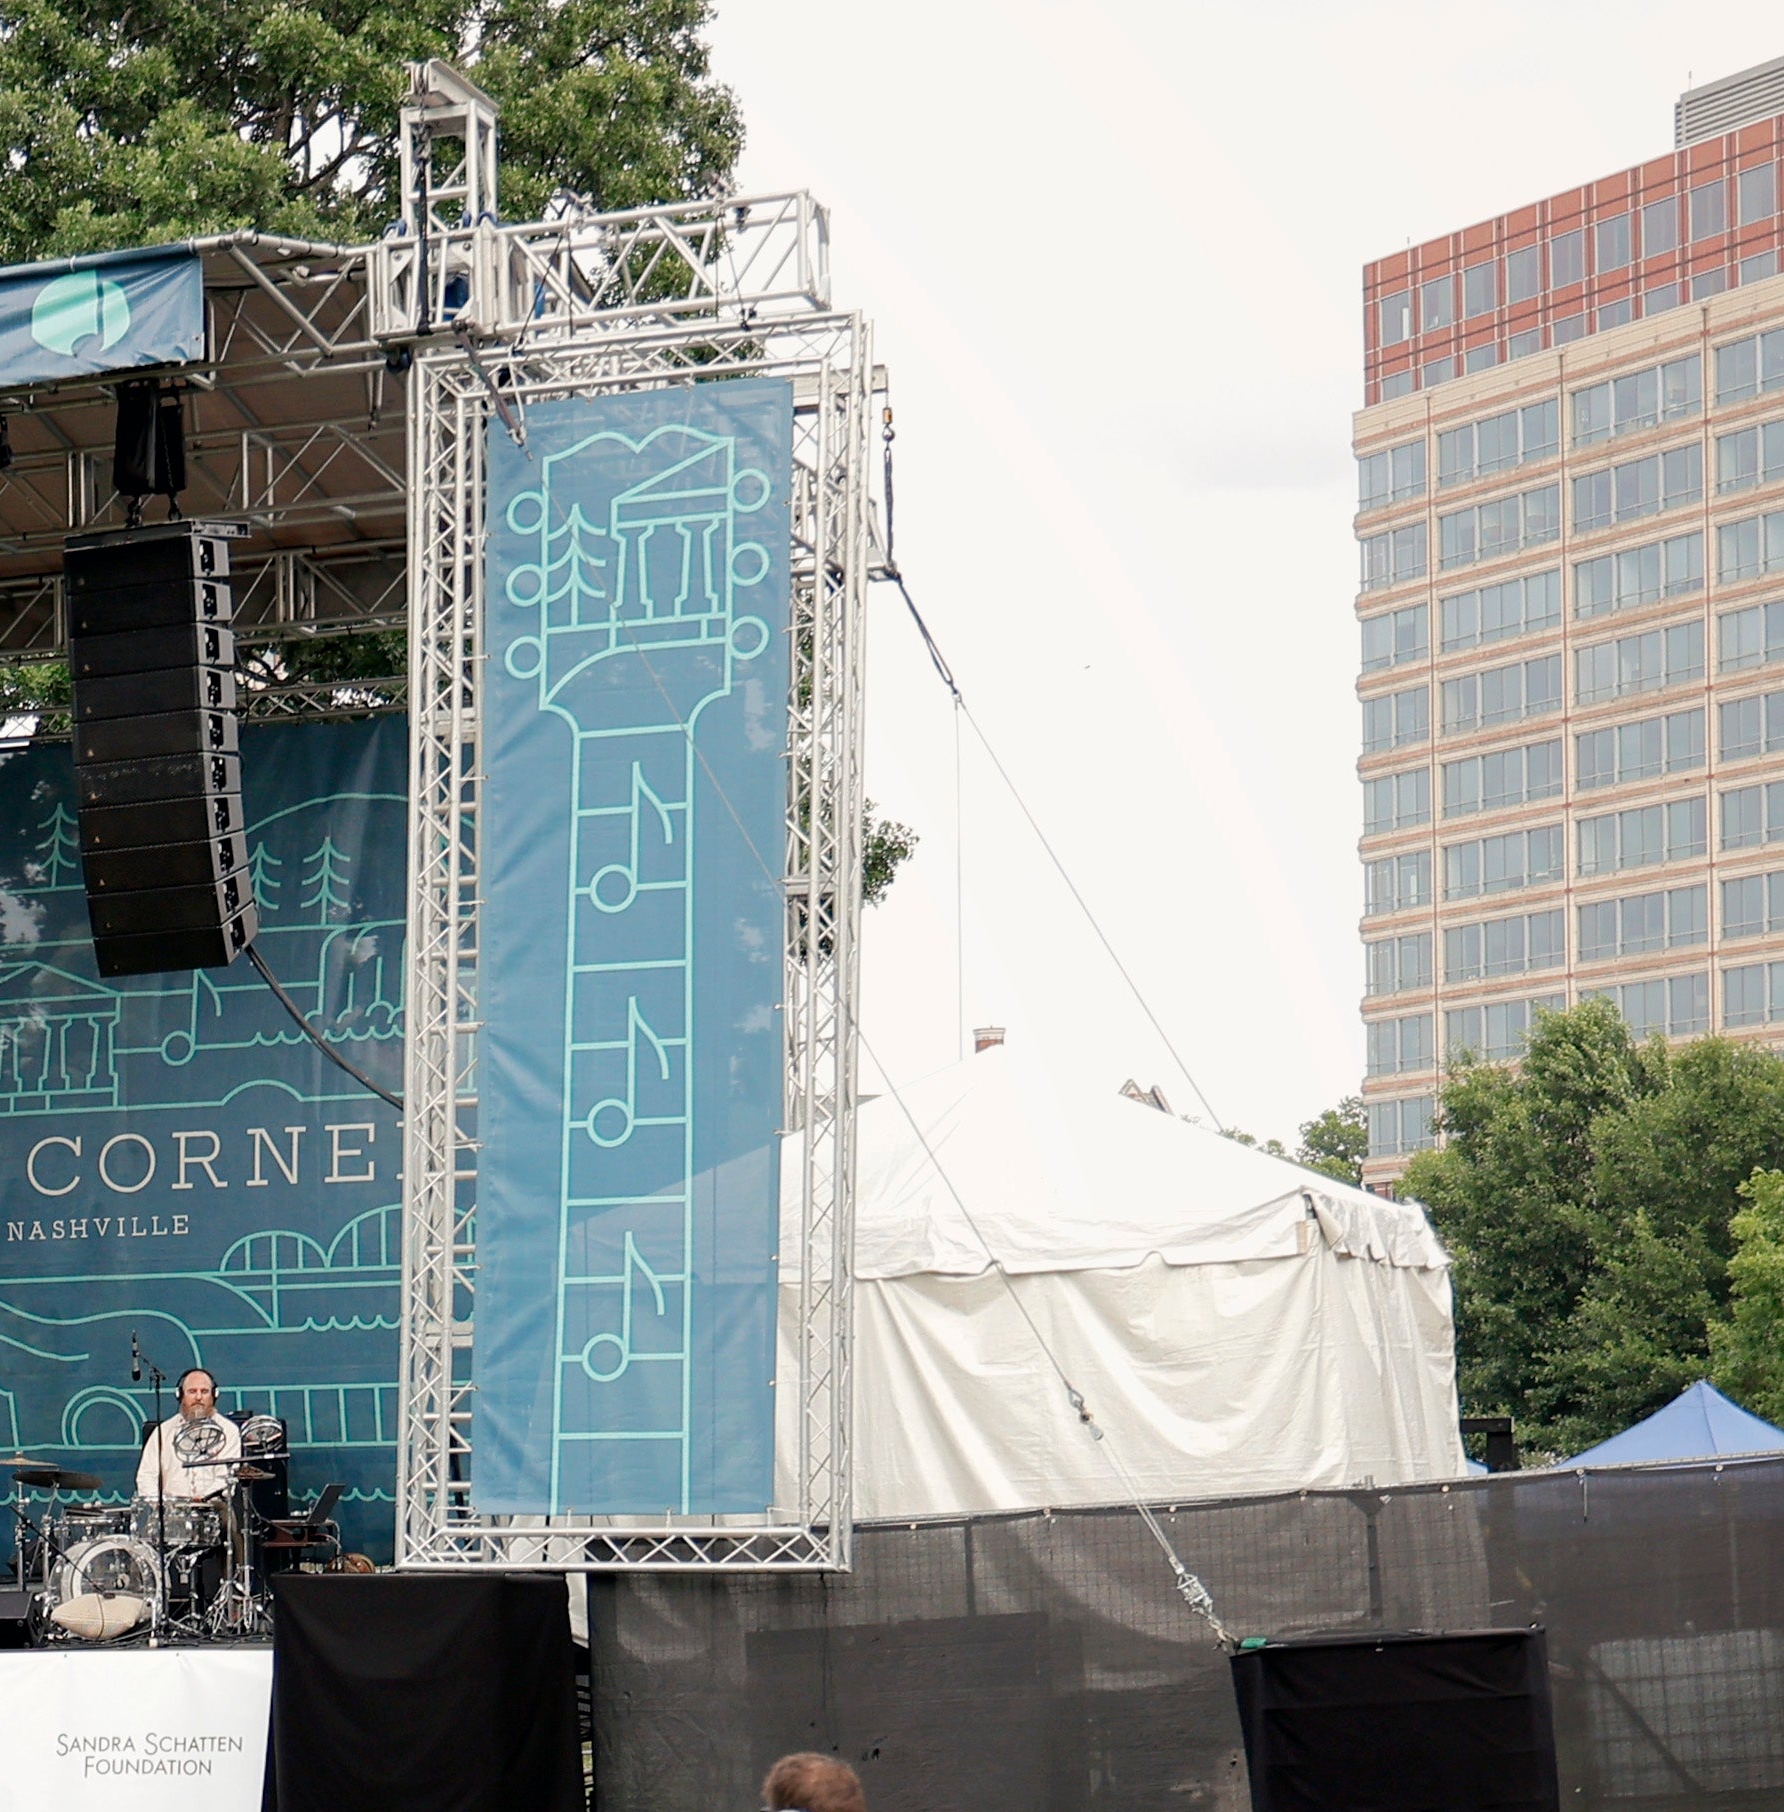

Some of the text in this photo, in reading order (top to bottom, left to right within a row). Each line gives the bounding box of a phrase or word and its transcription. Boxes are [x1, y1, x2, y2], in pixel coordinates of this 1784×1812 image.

[26, 1121, 405, 1197] CORNE
[7, 1214, 190, 1242] NASHVILLE
[56, 1732, 243, 1756] SANDRA SCHATTEN
[84, 1756, 212, 1778] FOUNDATION
